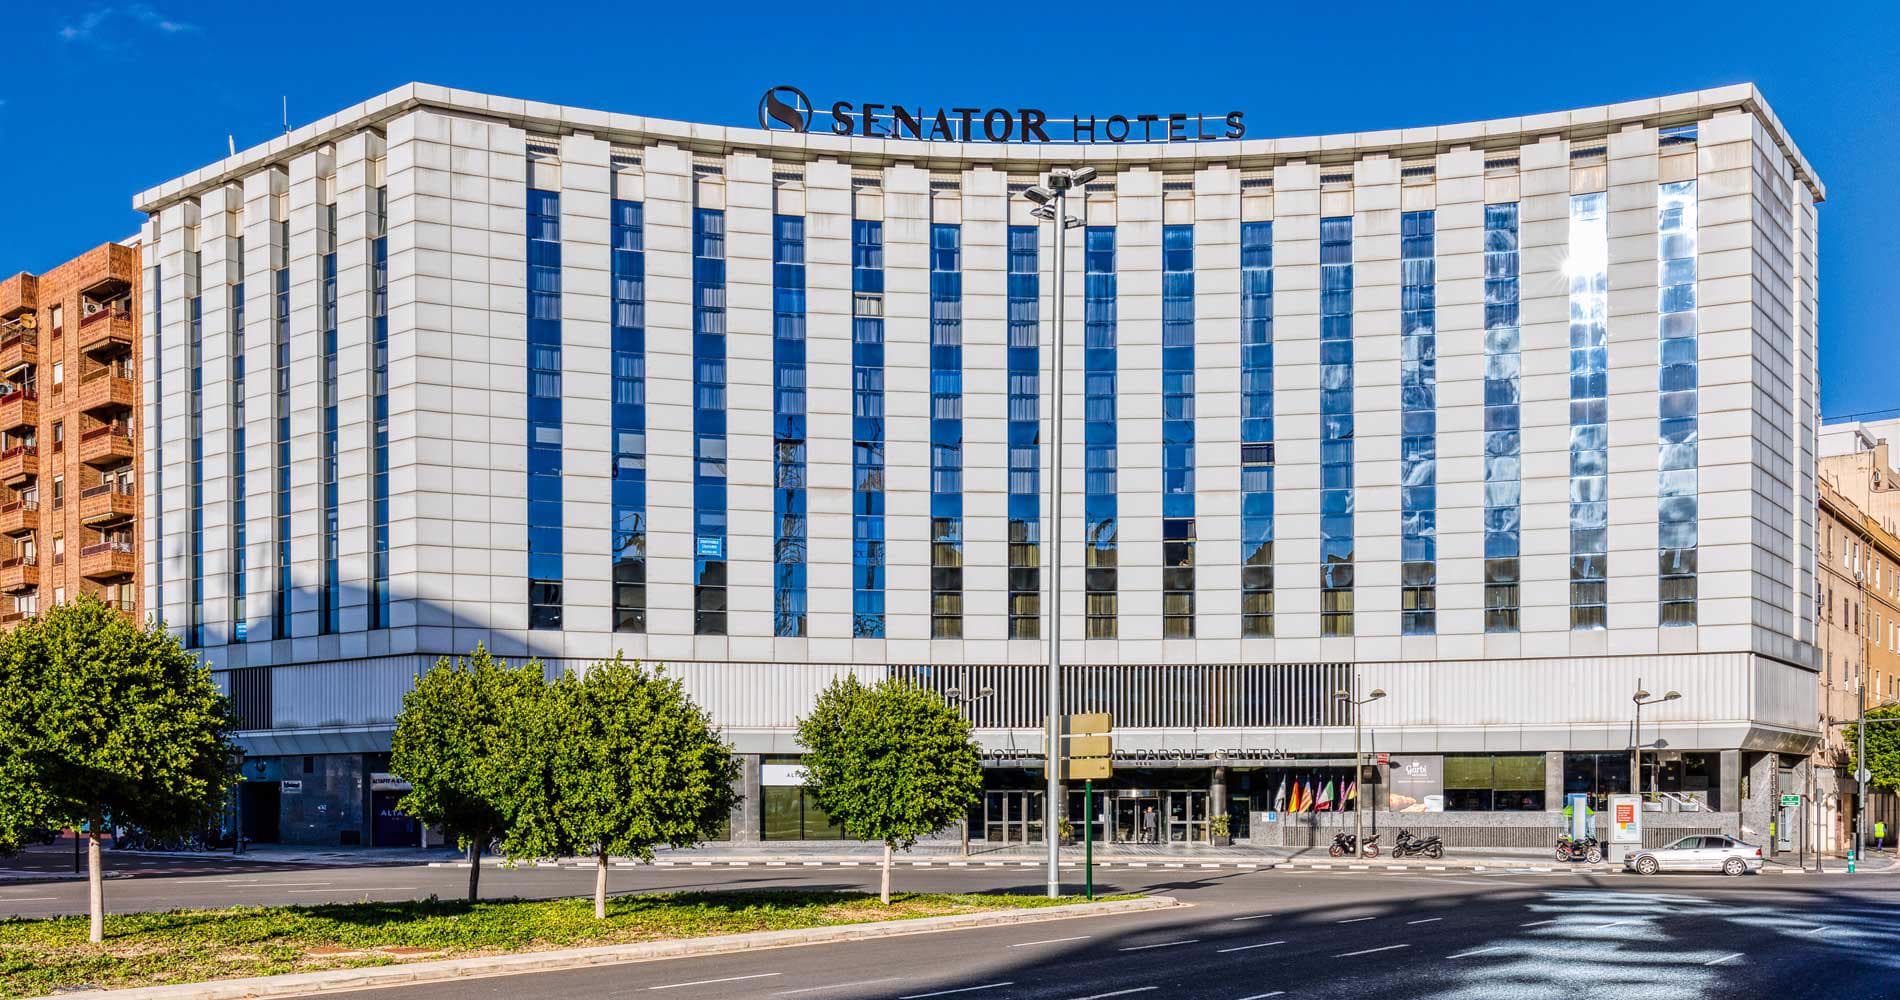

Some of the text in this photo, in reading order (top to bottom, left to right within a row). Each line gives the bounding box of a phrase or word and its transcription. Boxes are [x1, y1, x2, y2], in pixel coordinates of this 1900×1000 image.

[831, 101, 1245, 143] SENATOR HOTELS
[981, 748, 1036, 760] HOTEL
[1135, 748, 1206, 760] PARQUE
[1214, 748, 1295, 761] CENTRAL
